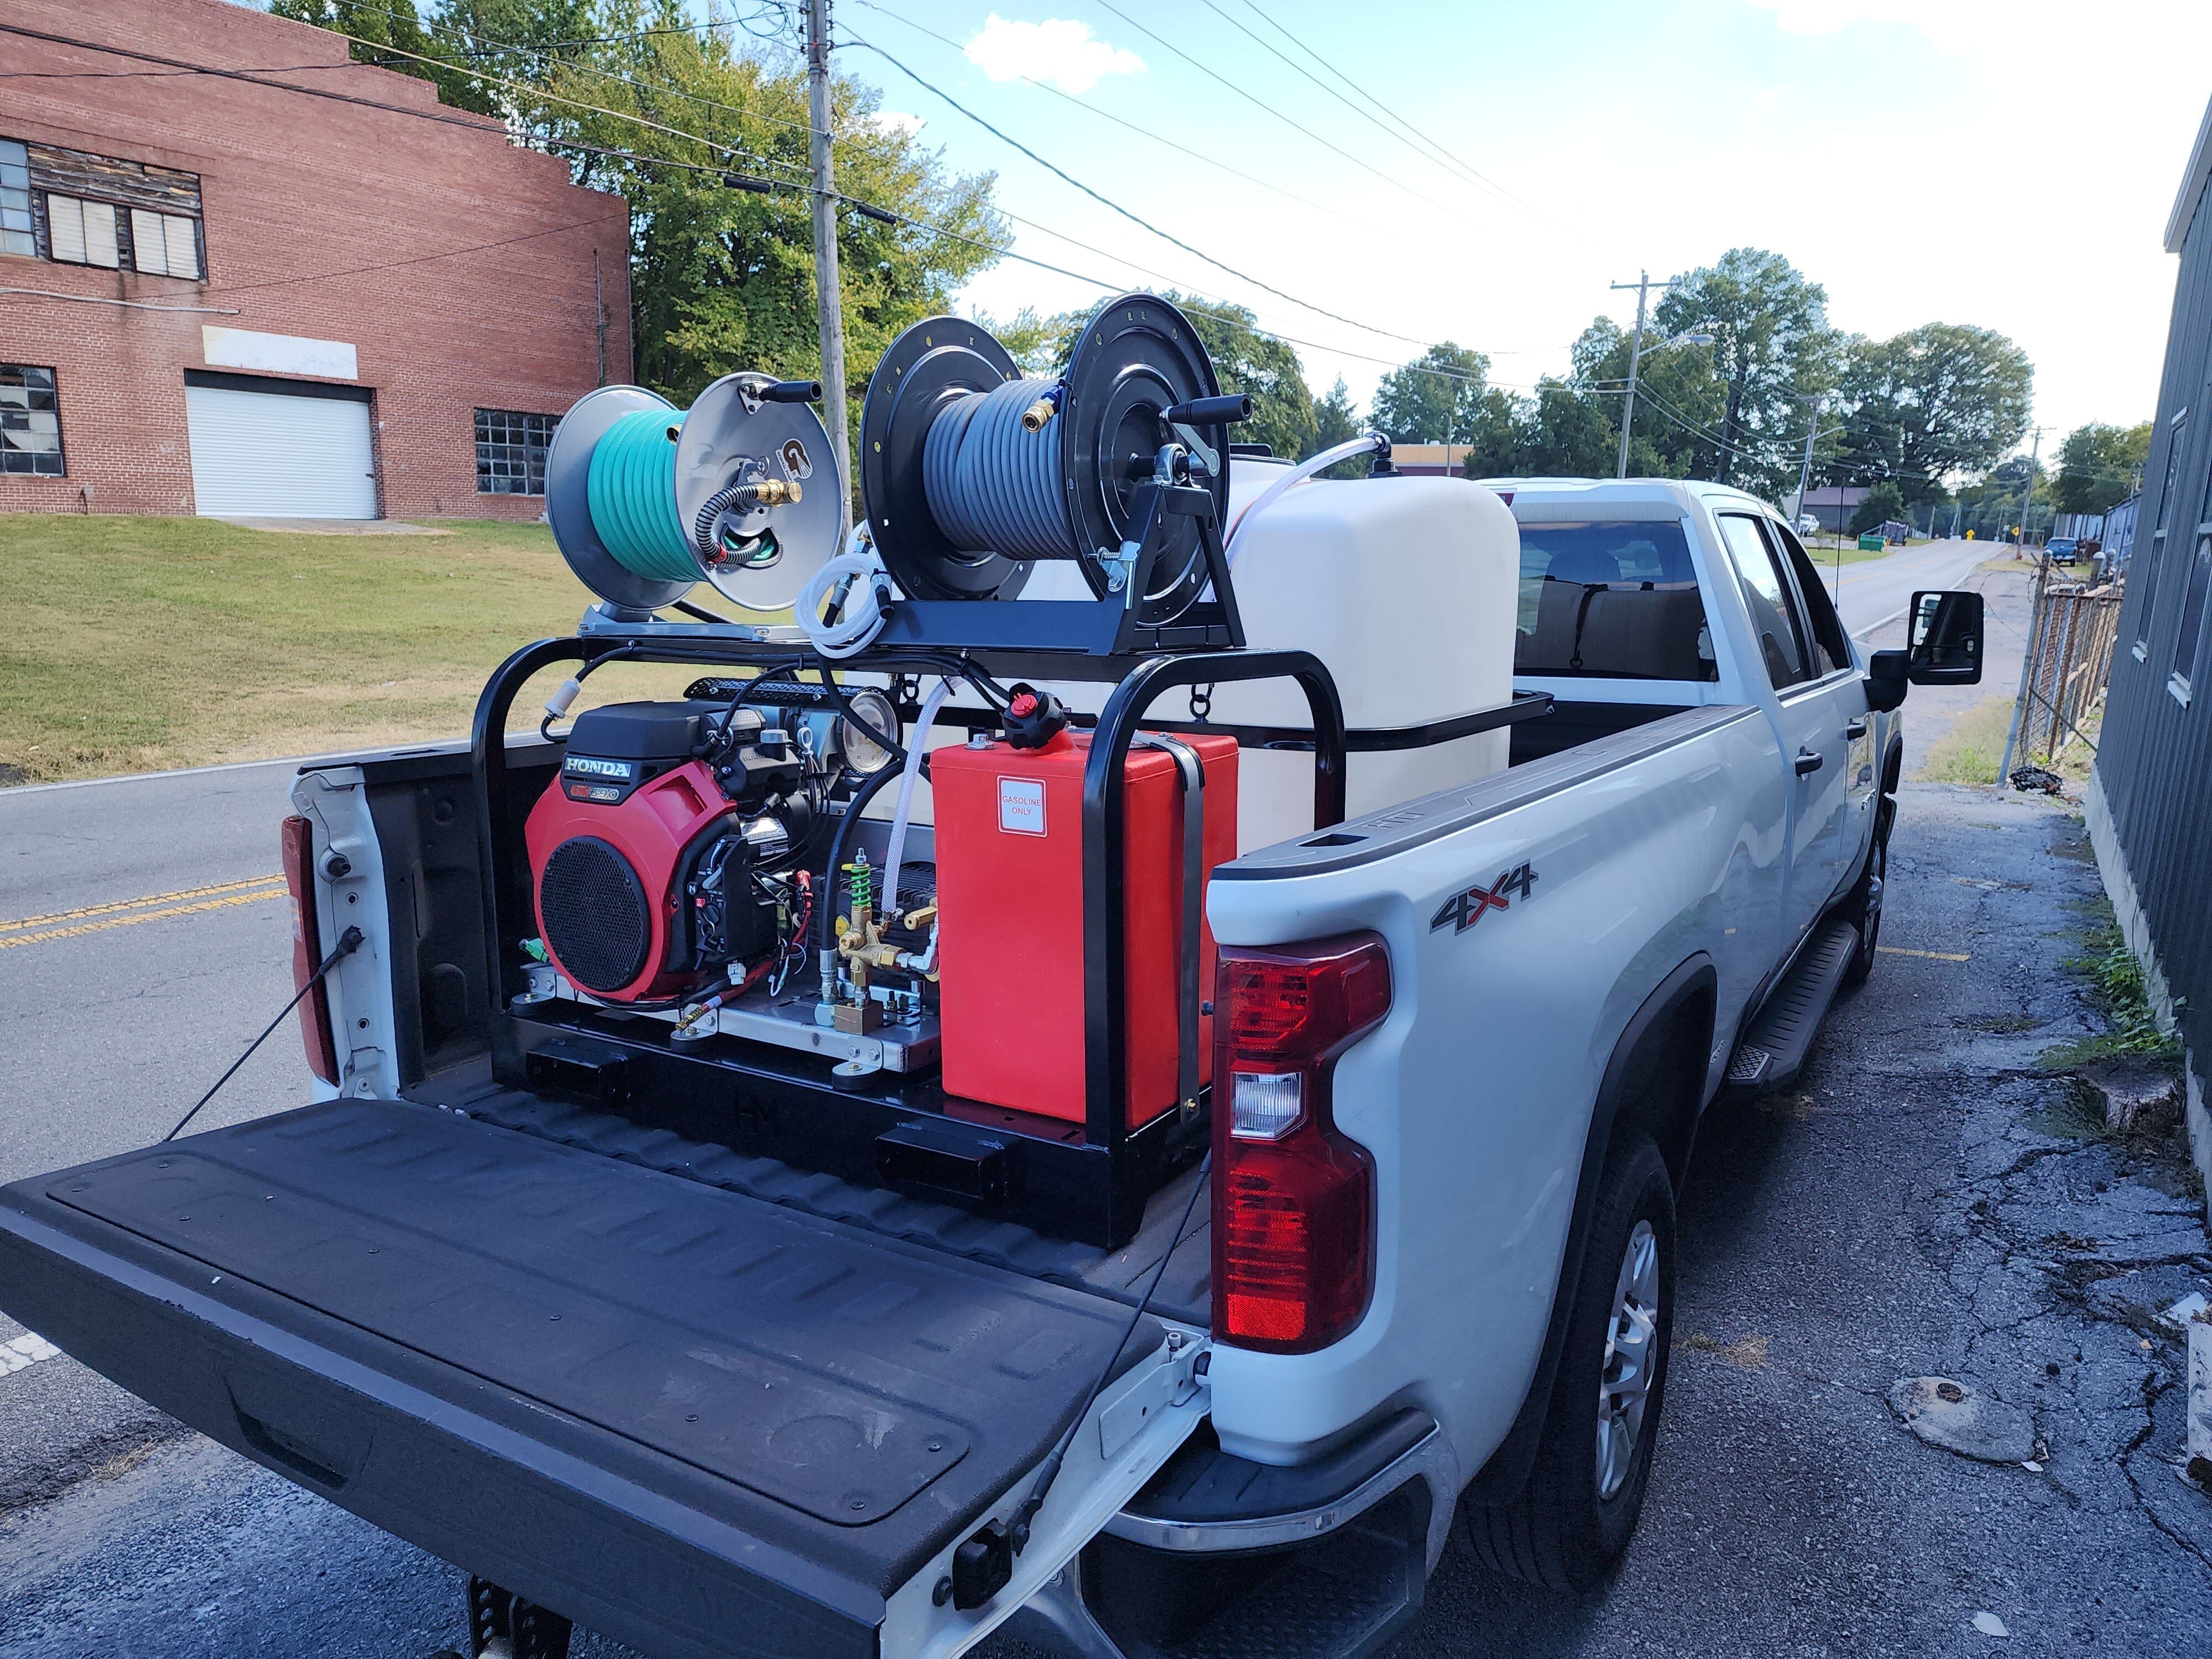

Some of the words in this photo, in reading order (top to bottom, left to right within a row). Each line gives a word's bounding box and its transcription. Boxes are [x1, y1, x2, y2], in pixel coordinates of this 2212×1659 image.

[777, 451, 786, 469] GENERAL
[565, 758, 630, 777] HONDA
[1003, 796, 1041, 806] GASOLINE
[1012, 807, 1032, 816] ONLY
